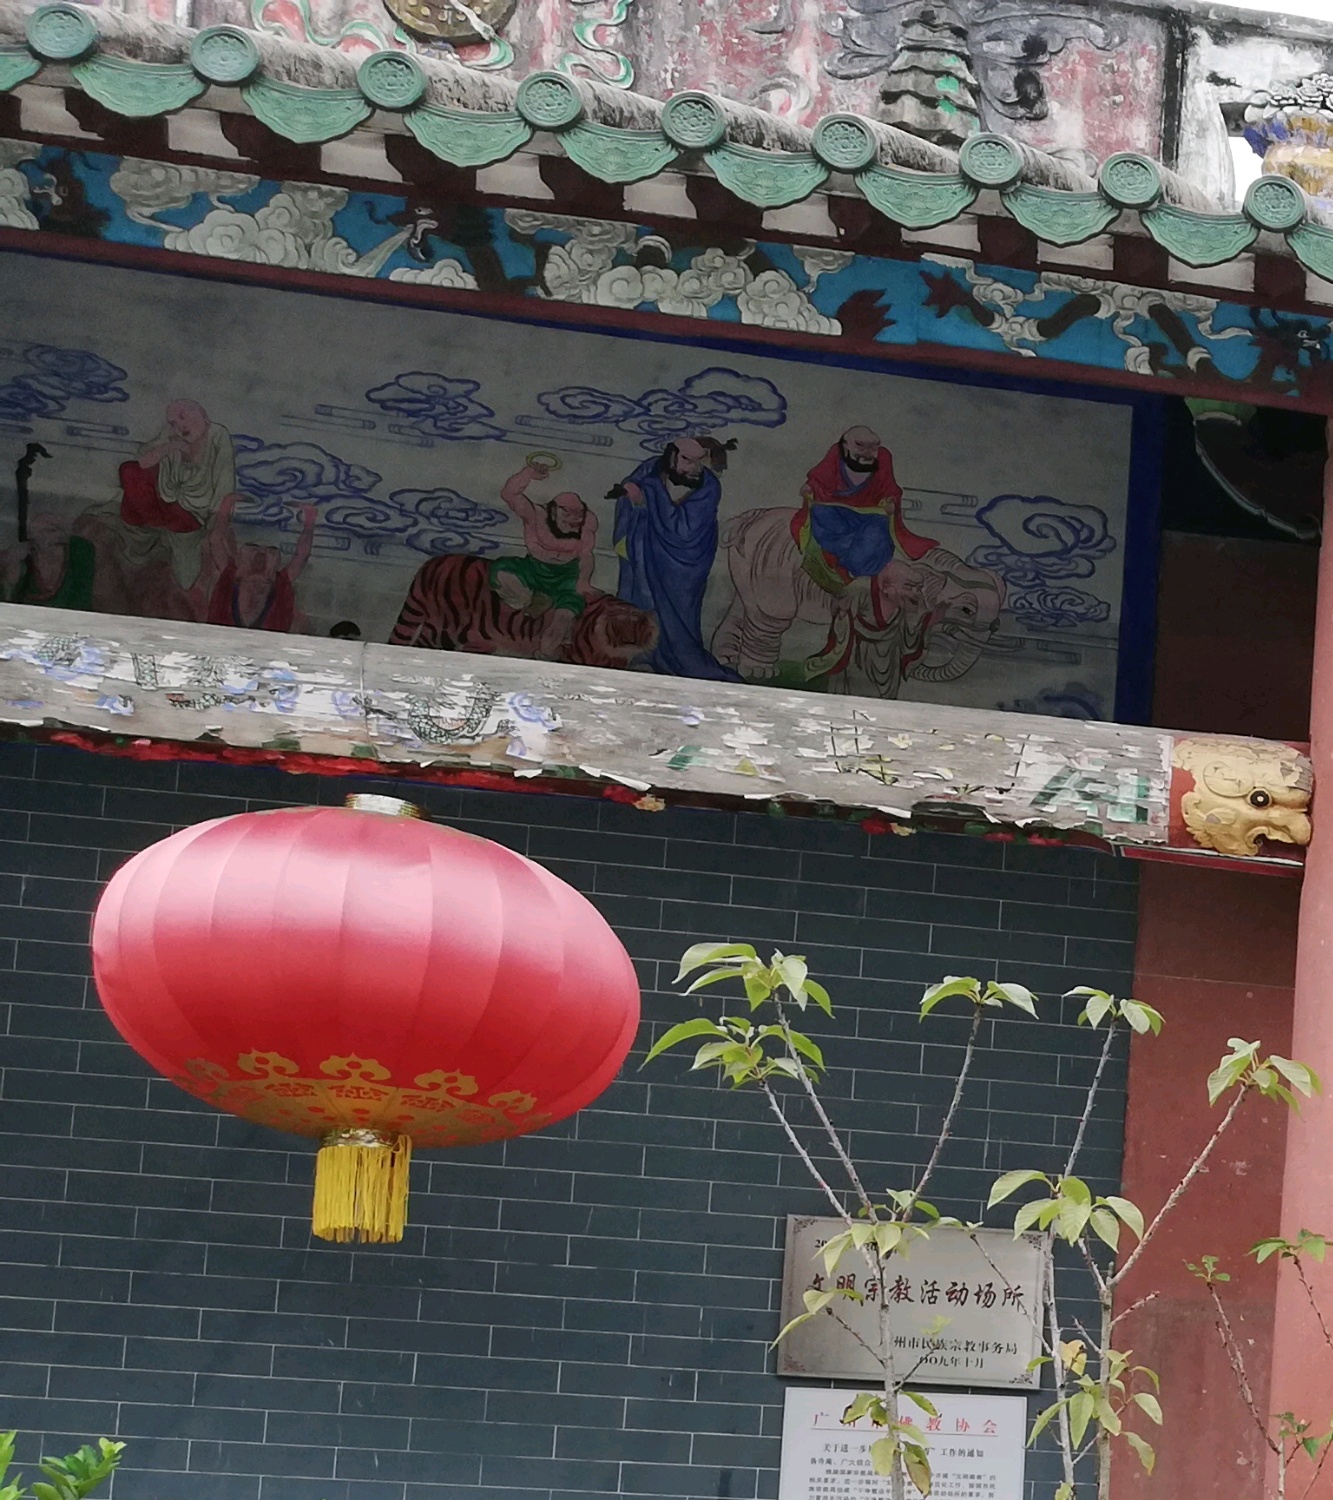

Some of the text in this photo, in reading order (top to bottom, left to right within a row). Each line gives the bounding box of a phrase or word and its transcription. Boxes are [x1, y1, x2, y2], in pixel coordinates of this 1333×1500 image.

[880, 1335, 1018, 1355] 州市民族宗教事务局
[813, 1411, 998, 1434] 广佛教协会
